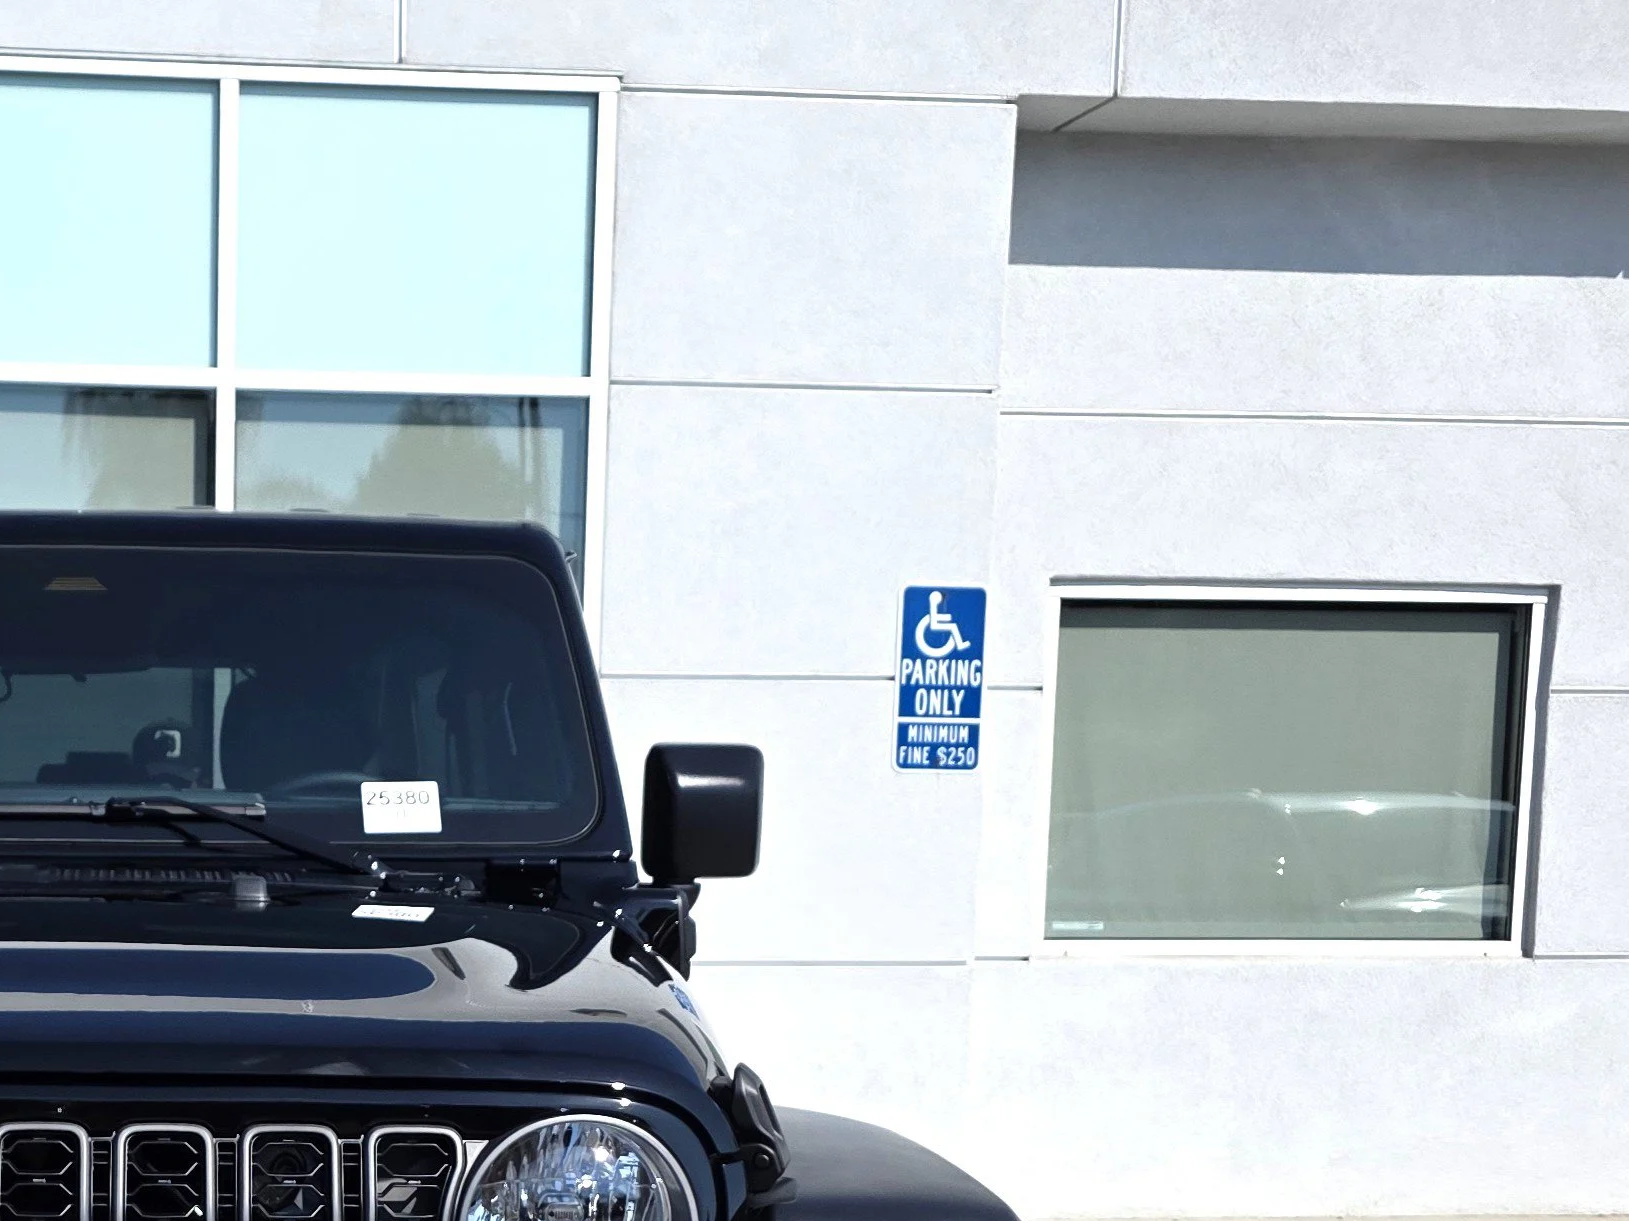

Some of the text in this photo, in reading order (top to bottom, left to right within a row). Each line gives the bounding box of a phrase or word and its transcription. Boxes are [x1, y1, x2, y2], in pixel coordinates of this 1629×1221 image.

[901, 658, 981, 687] PARKING
[914, 688, 965, 715] ONLY
[907, 724, 969, 743] MINIMUM
[899, 745, 976, 766] FINE $250
[366, 790, 430, 806] 25380
